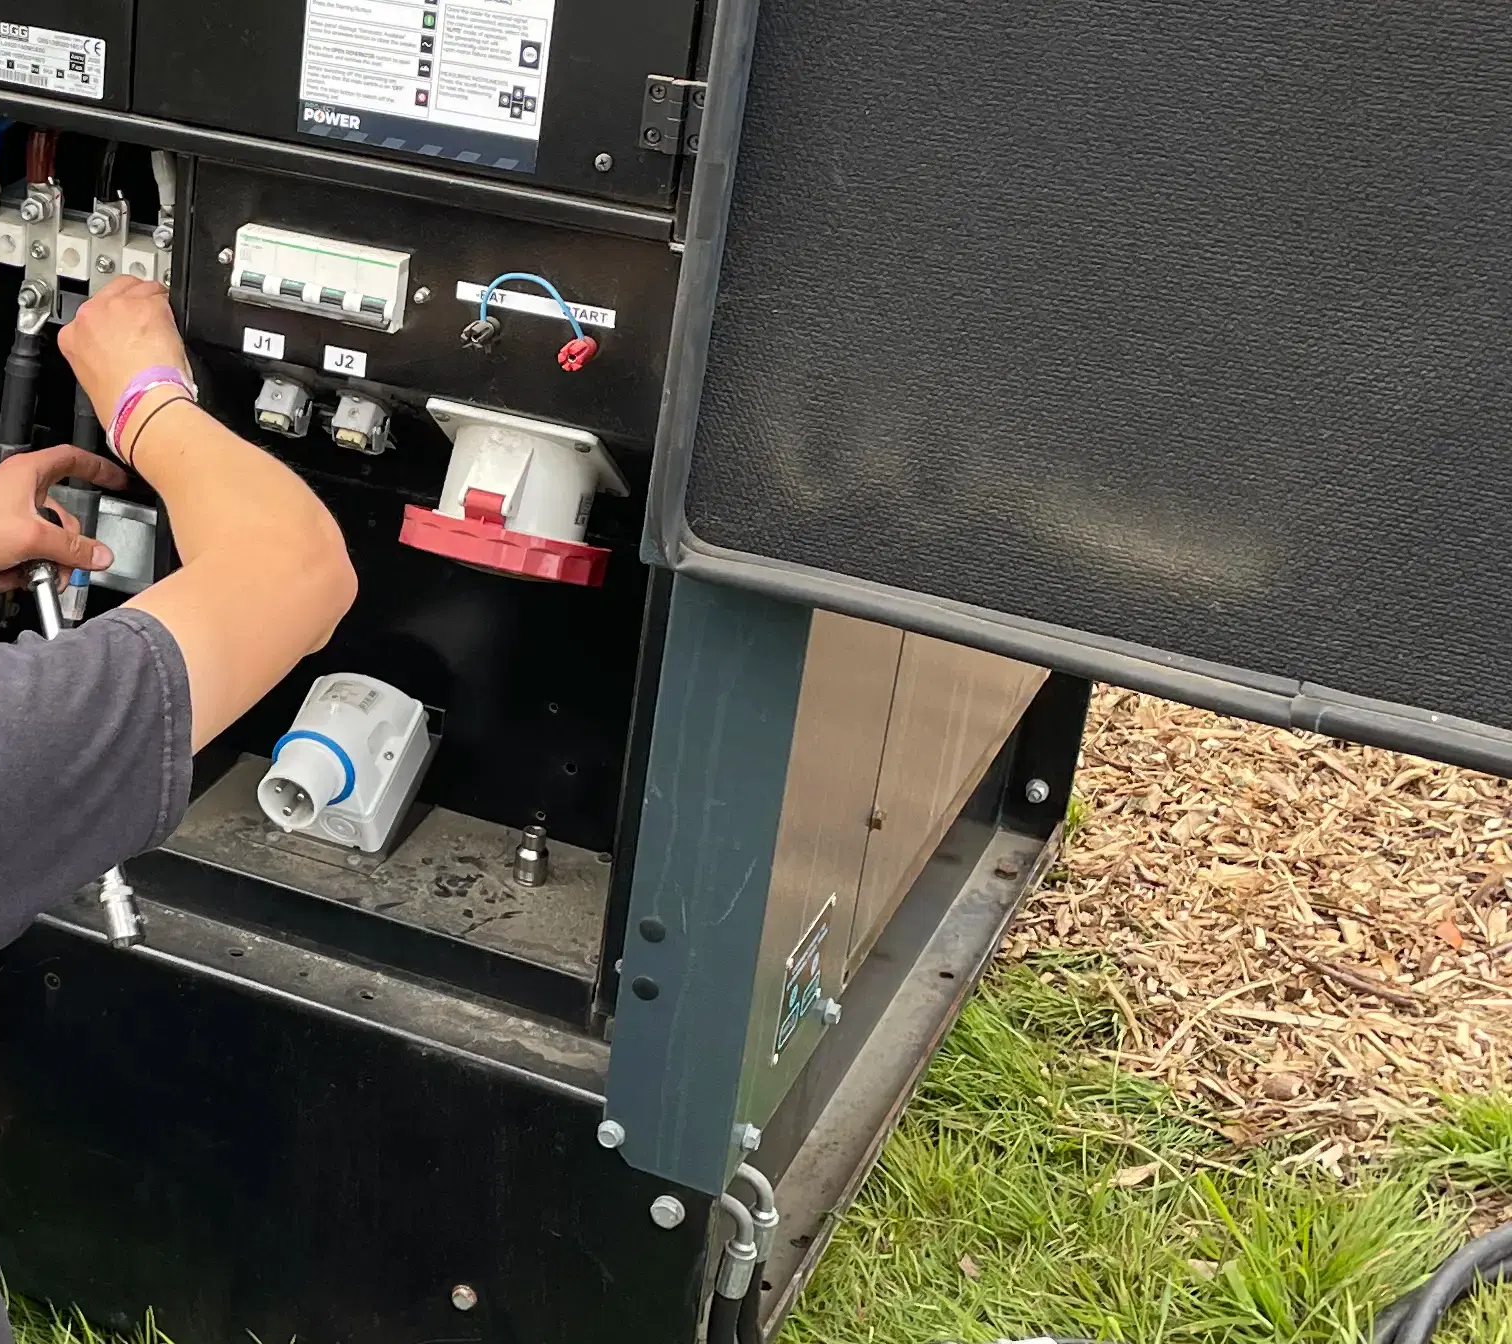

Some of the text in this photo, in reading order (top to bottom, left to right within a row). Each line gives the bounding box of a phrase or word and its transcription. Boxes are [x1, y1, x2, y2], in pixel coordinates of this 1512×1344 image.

[302, 106, 361, 130] POWER
[563, 306, 608, 323] TART
[253, 335, 271, 352] J1
[334, 354, 355, 371] J2
